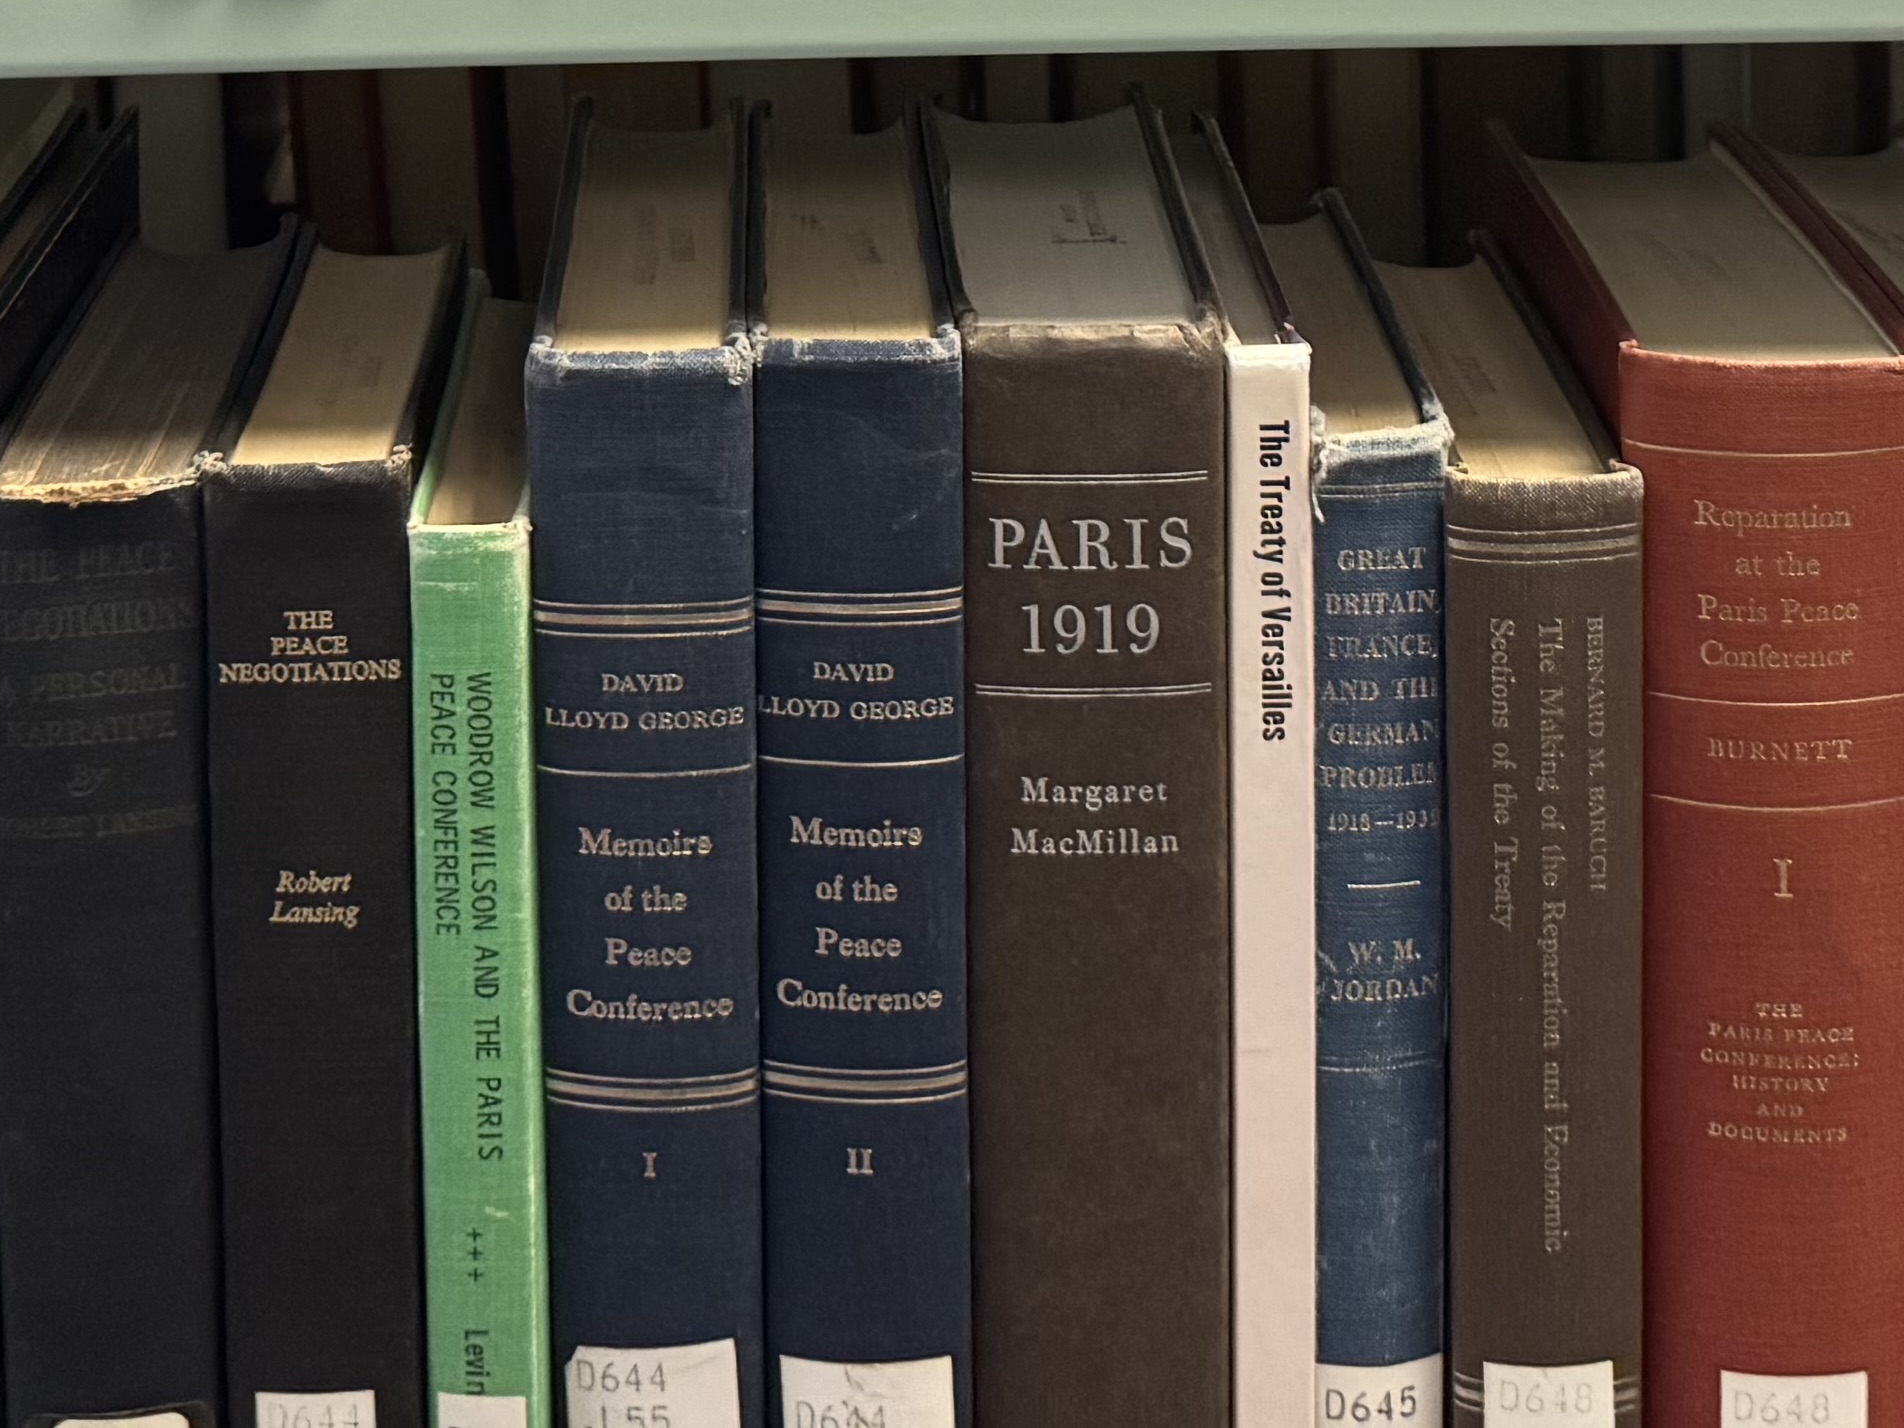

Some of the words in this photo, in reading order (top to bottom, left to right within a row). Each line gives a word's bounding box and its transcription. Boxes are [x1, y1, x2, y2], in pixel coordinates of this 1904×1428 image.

[1259, 420, 1290, 468] The
[1252, 475, 1290, 564] Treaty
[988, 517, 1193, 571] PARIS
[1260, 571, 1291, 598] of
[1020, 604, 1160, 657] 1919
[219, 660, 401, 685] NEGOTIATIONS
[1261, 606, 1293, 742] Versailles
[430, 673, 456, 755] PEACE
[1021, 777, 1167, 810] Margaret
[431, 770, 461, 937] CONFERENCE
[1011, 827, 1179, 856] MacMillan
[277, 872, 352, 894] Robert
[271, 899, 360, 930] Lansing
